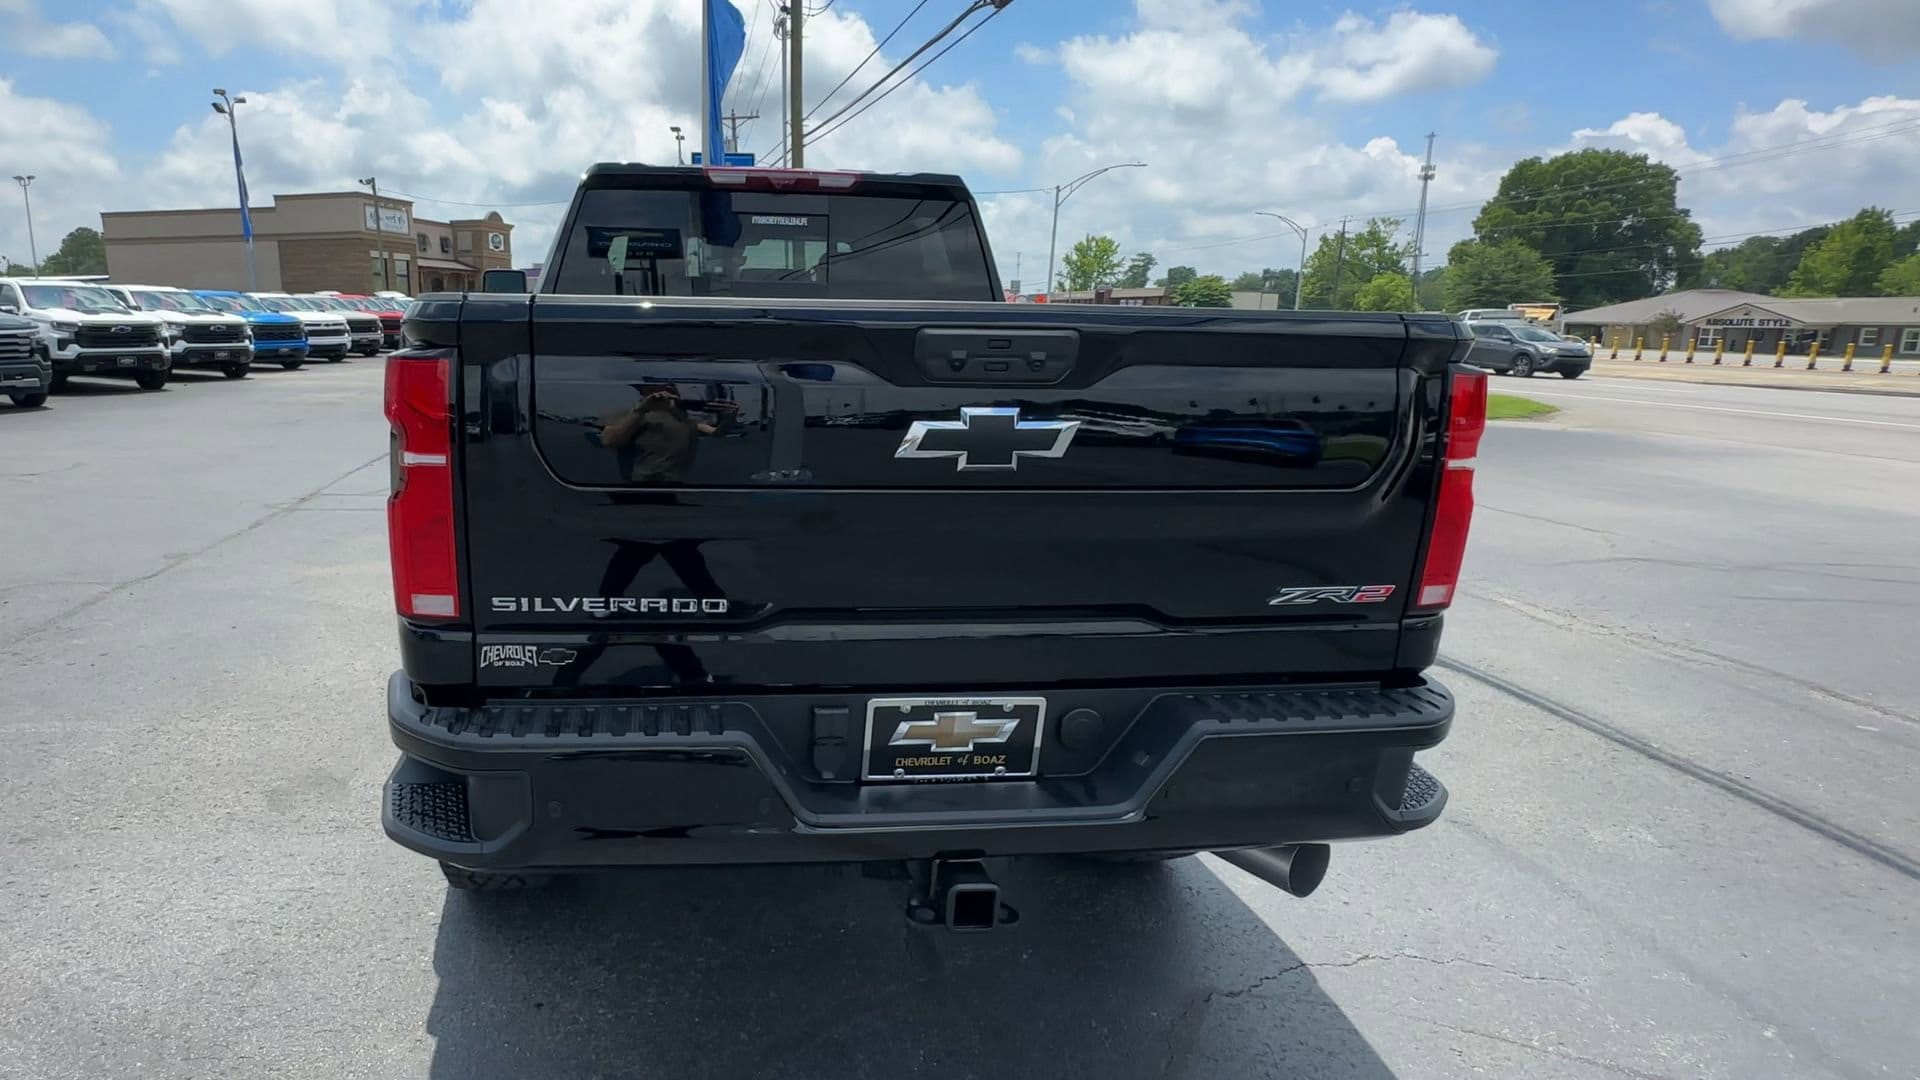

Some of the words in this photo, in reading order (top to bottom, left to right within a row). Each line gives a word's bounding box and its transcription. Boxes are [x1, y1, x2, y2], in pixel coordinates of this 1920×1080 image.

[1705, 318, 1755, 327] ABSOLUTE
[1758, 319, 1792, 327] STYLE
[1268, 584, 1396, 606] ZR2
[491, 597, 728, 613] SILVERADO
[480, 644, 538, 668] CHEVROLET
[895, 756, 953, 767] CHEVROLET
[957, 753, 969, 767] of
[973, 755, 1006, 766] BOAZ
